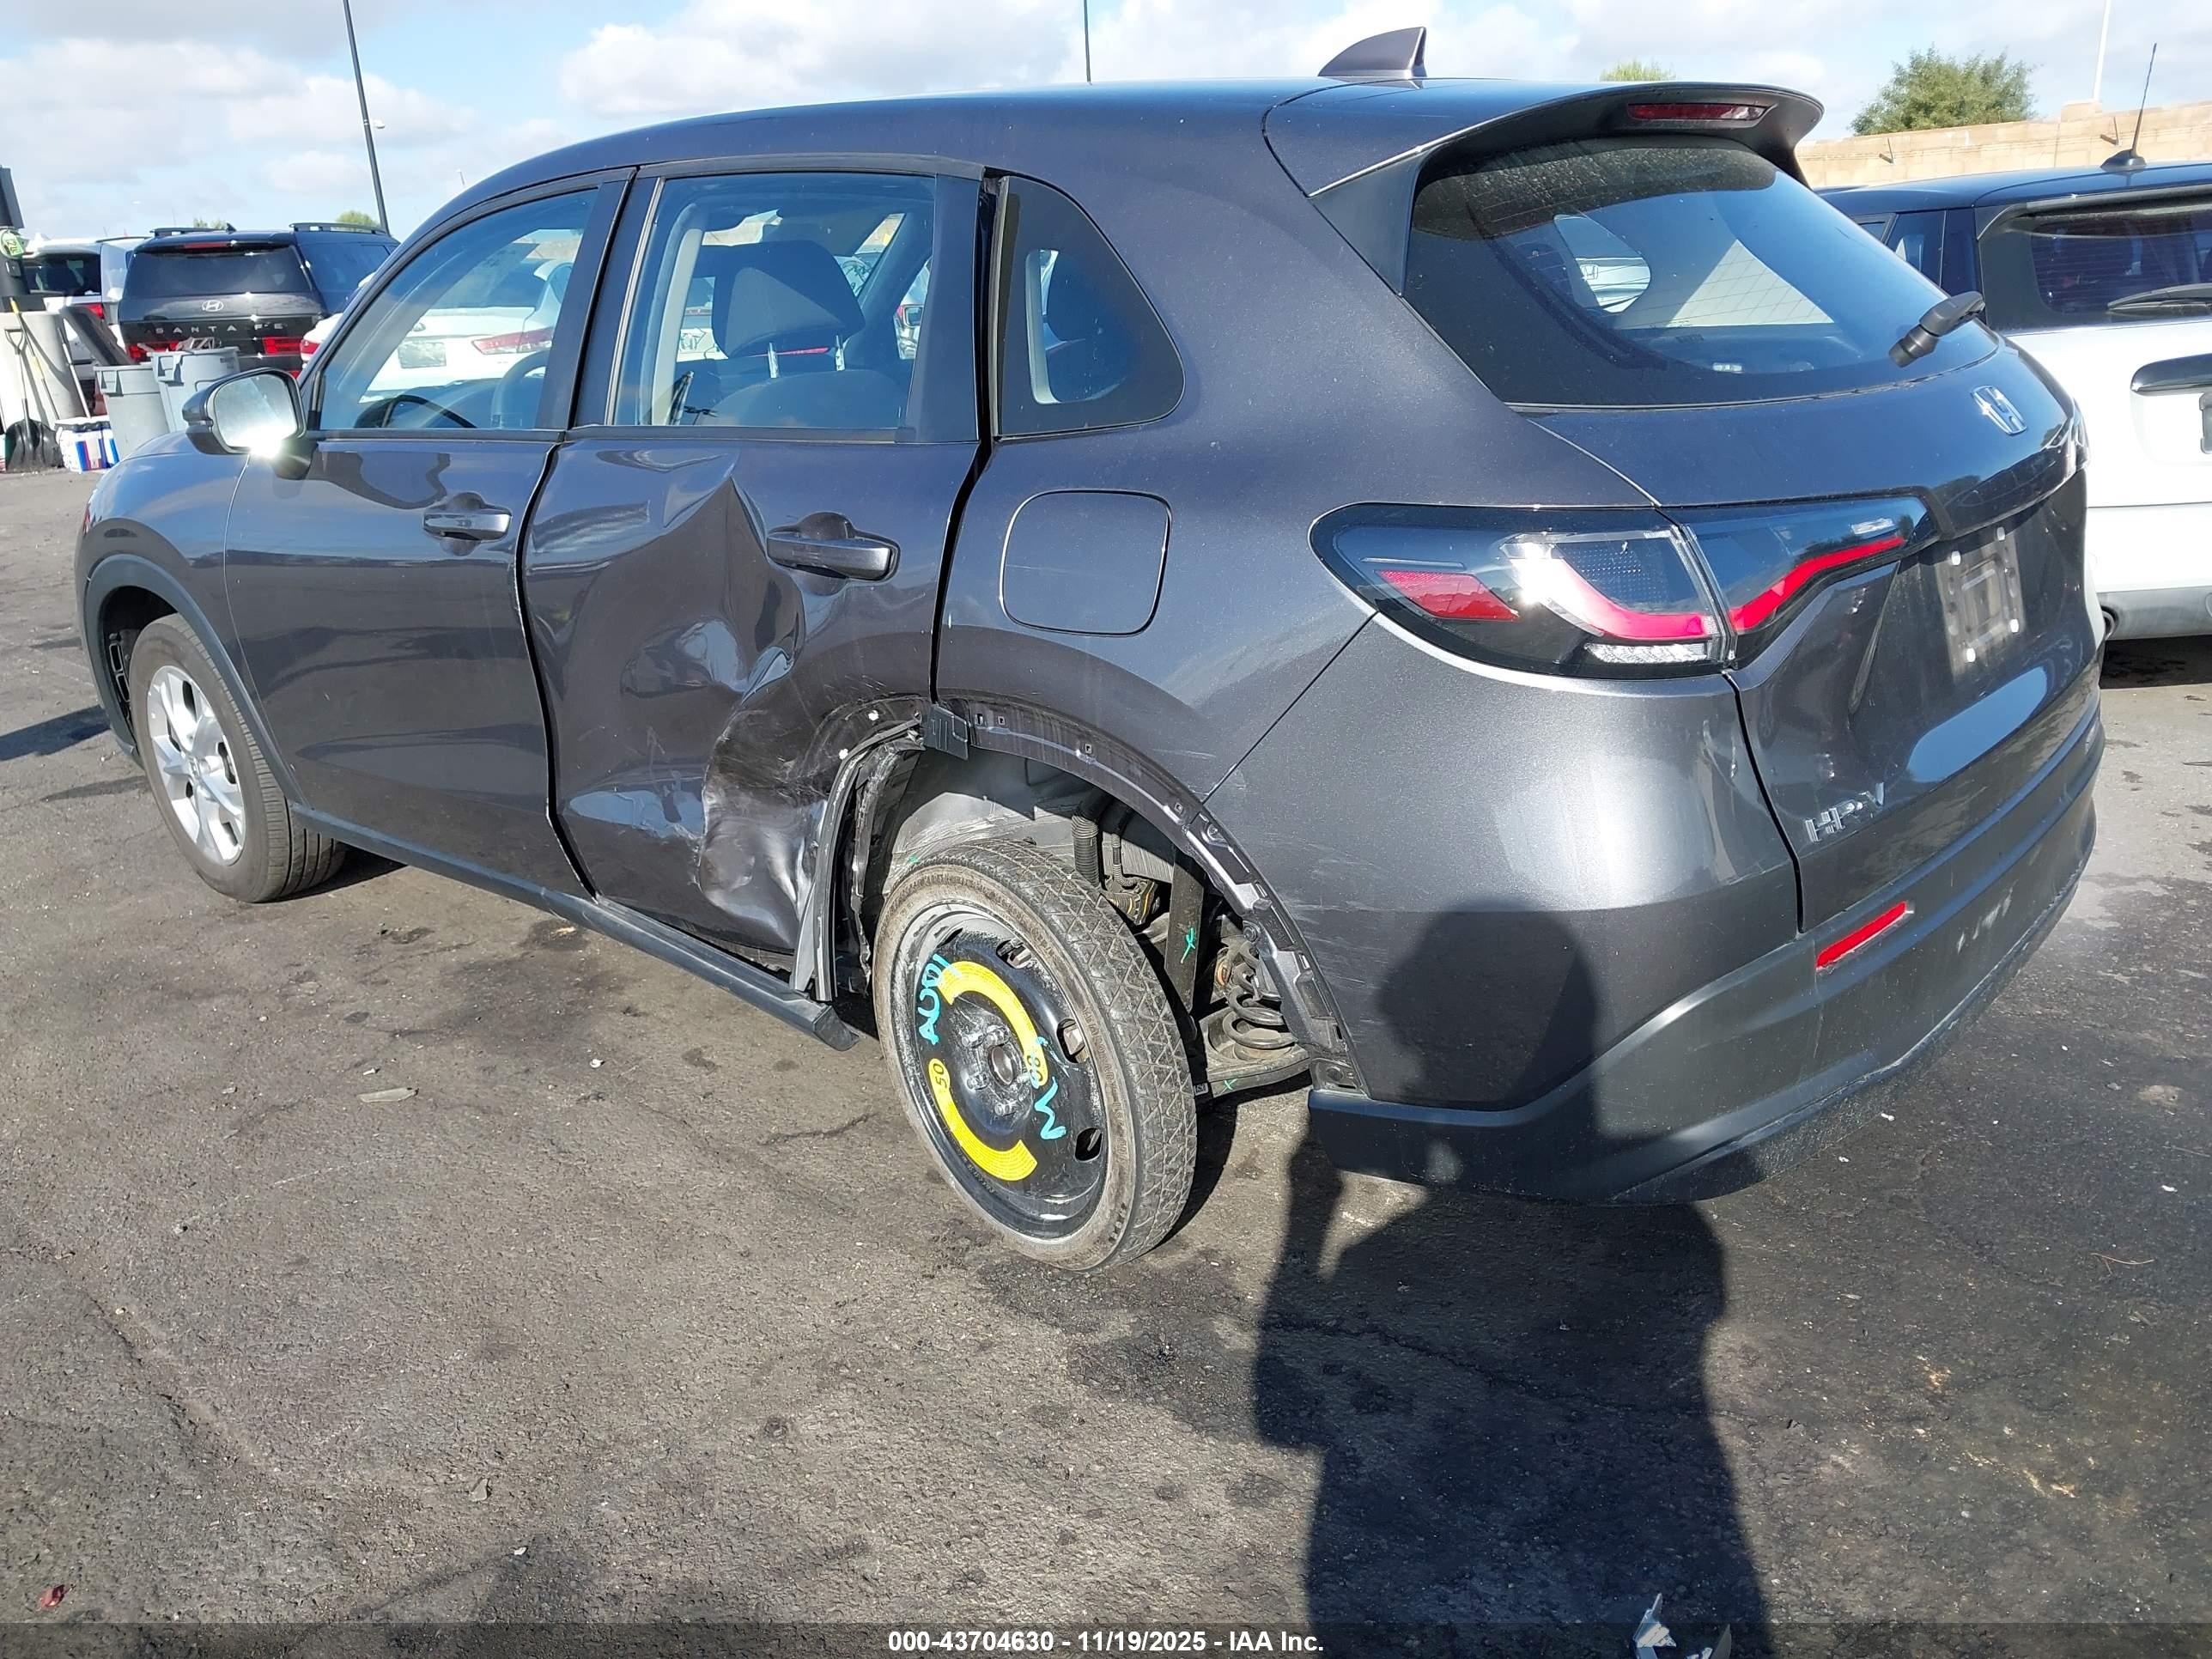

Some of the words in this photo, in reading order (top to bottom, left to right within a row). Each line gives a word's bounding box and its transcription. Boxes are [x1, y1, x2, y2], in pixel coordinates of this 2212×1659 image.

[155, 324, 238, 335] SANTA
[253, 322, 284, 331] FE
[1804, 781, 1885, 843] HR-V
[917, 953, 963, 1046] AUDI
[932, 1062, 949, 1090] 50
